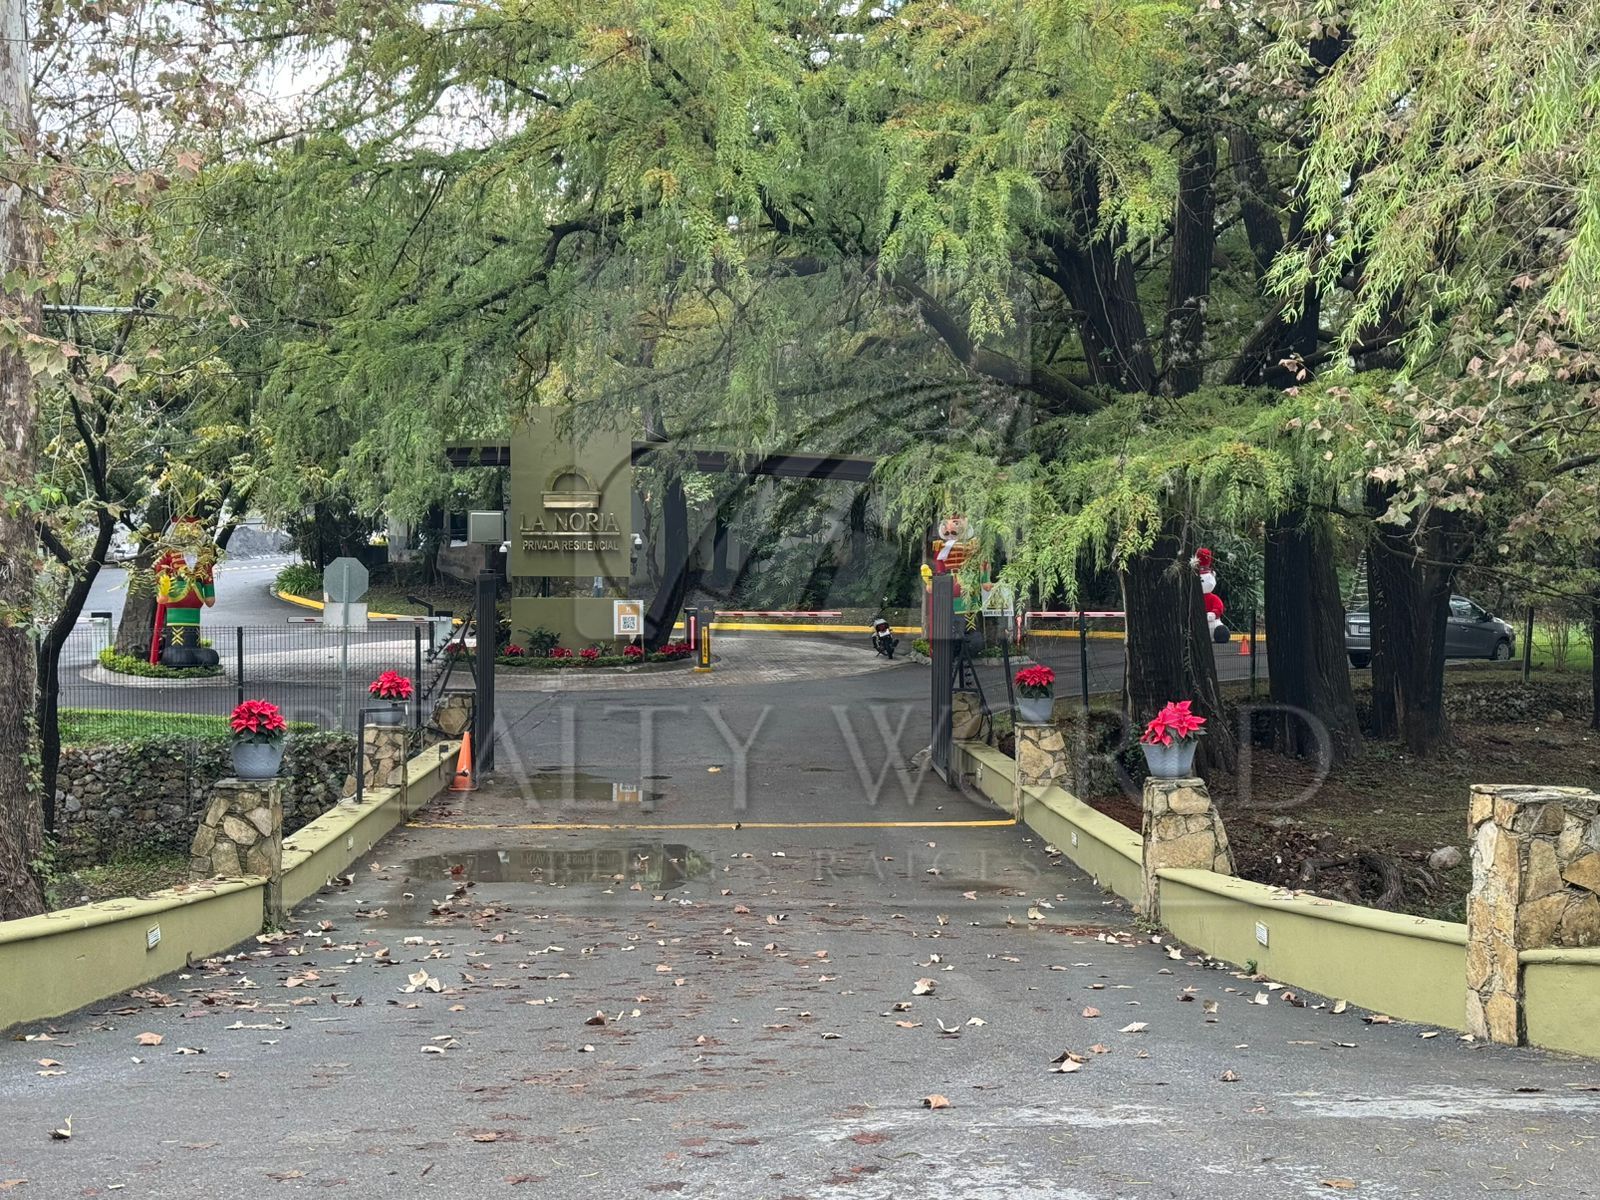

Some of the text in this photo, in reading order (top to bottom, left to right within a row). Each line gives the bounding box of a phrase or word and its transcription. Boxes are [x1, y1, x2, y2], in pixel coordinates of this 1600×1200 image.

[520, 512, 619, 531] LA NORIA
[522, 540, 619, 551] PRIVADA RESIDENCIAL
